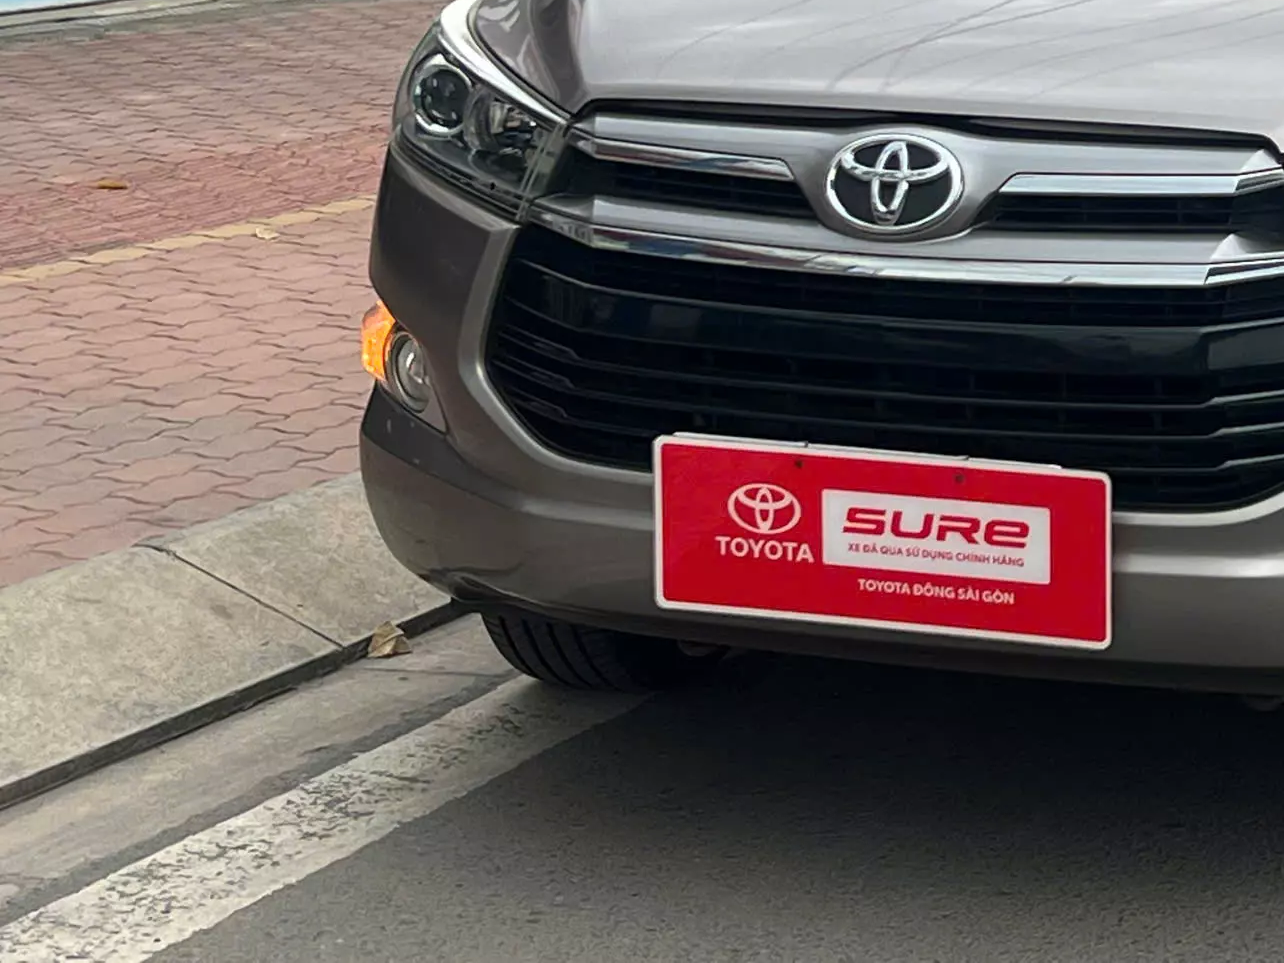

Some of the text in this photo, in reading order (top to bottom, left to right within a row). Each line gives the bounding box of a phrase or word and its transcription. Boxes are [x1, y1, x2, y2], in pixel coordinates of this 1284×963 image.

[715, 535, 815, 564] TOYOTA
[848, 543, 860, 553] XE
[881, 545, 903, 557] QUA
[857, 578, 911, 595] TOYOTA
[913, 582, 955, 600] ĐÔNG
